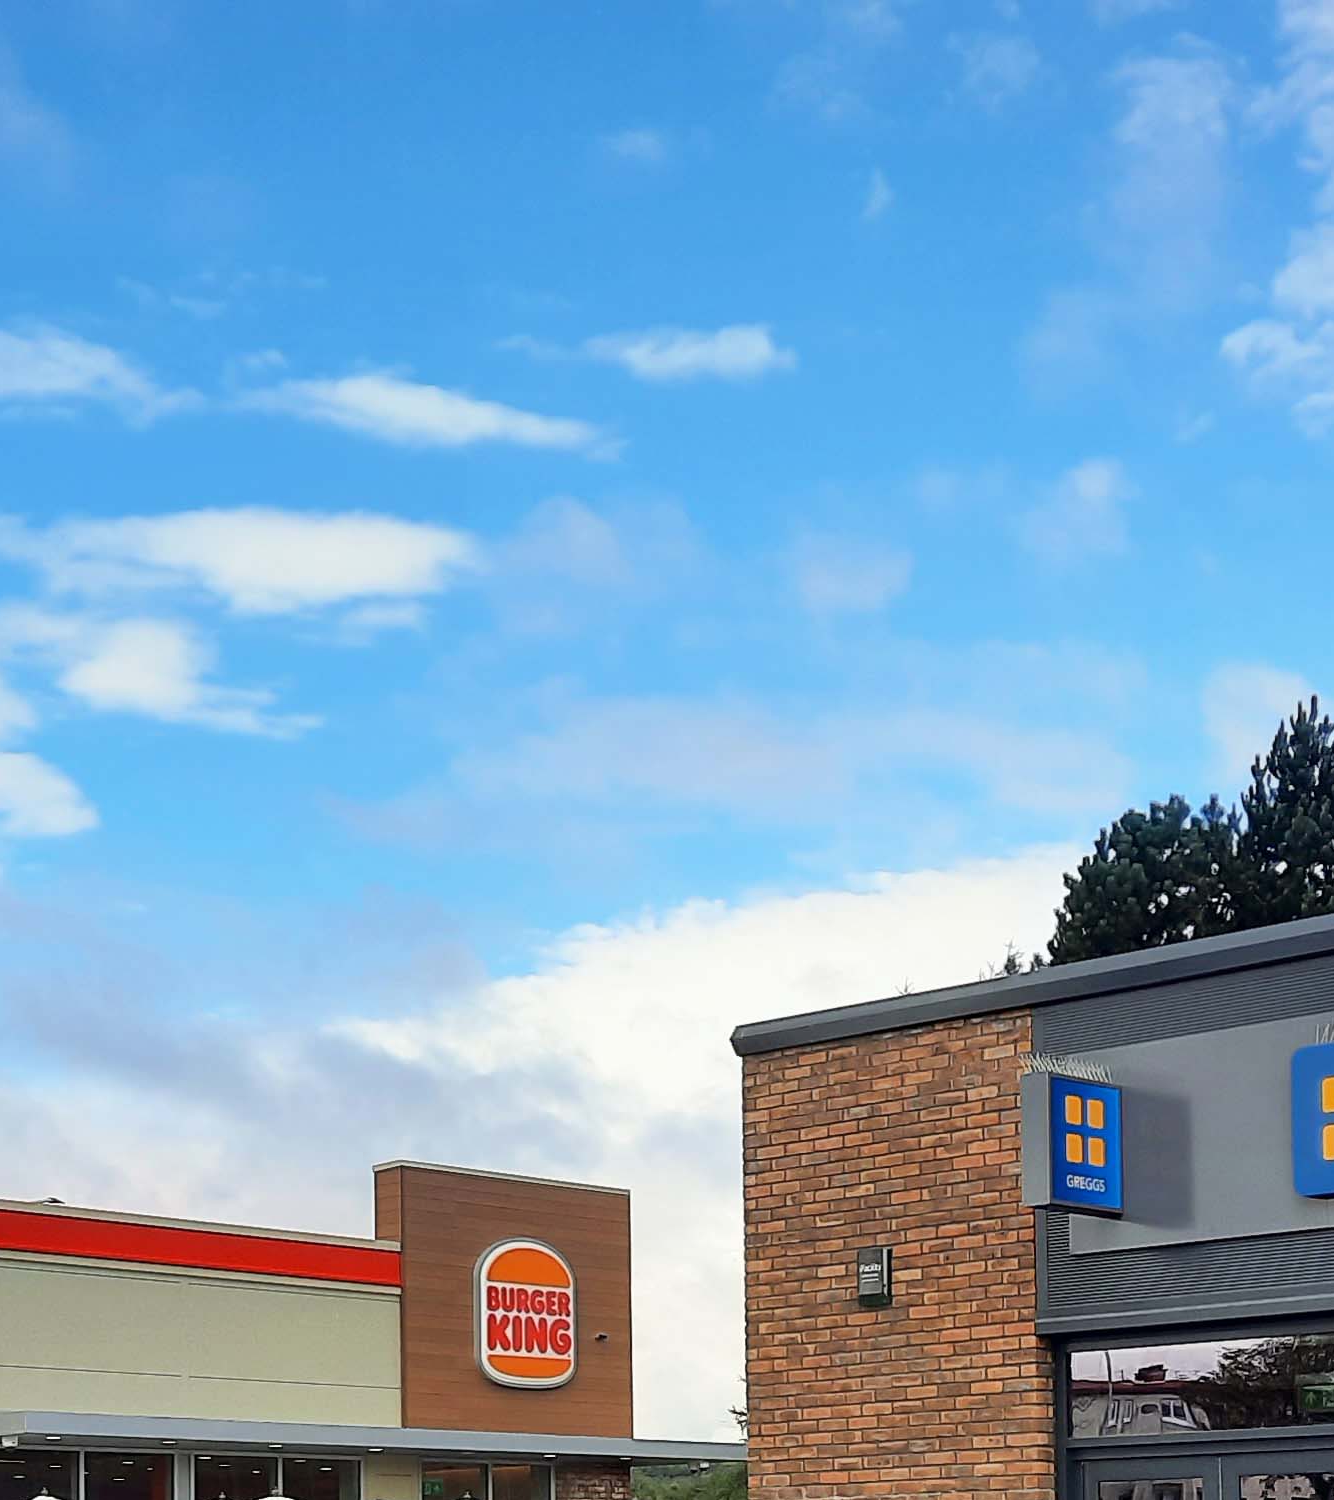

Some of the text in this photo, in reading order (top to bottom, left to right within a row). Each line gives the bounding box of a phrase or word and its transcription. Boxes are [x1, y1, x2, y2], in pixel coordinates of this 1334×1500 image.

[1067, 1174, 1106, 1193] GREGGS
[486, 1285, 571, 1317] BURGER
[486, 1313, 572, 1355] KING
